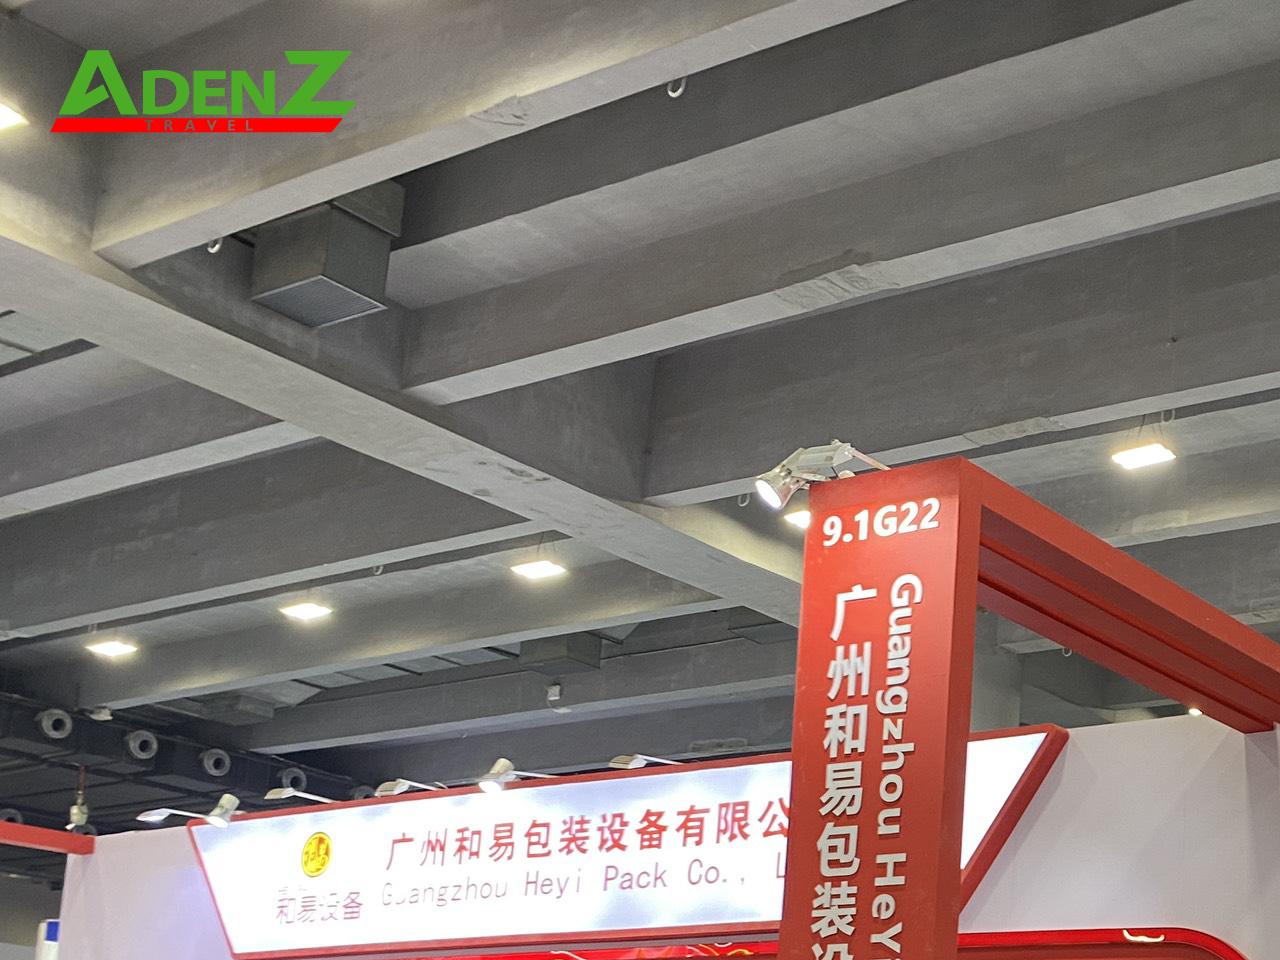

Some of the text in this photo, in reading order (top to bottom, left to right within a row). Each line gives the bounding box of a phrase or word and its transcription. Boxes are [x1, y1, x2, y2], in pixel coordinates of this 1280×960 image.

[822, 497, 941, 547] 9.1G22
[875, 573, 923, 836] Guangzhou
[382, 876, 508, 907] Guangzhou
[524, 867, 582, 900] Heyi
[602, 858, 667, 893] Pack
